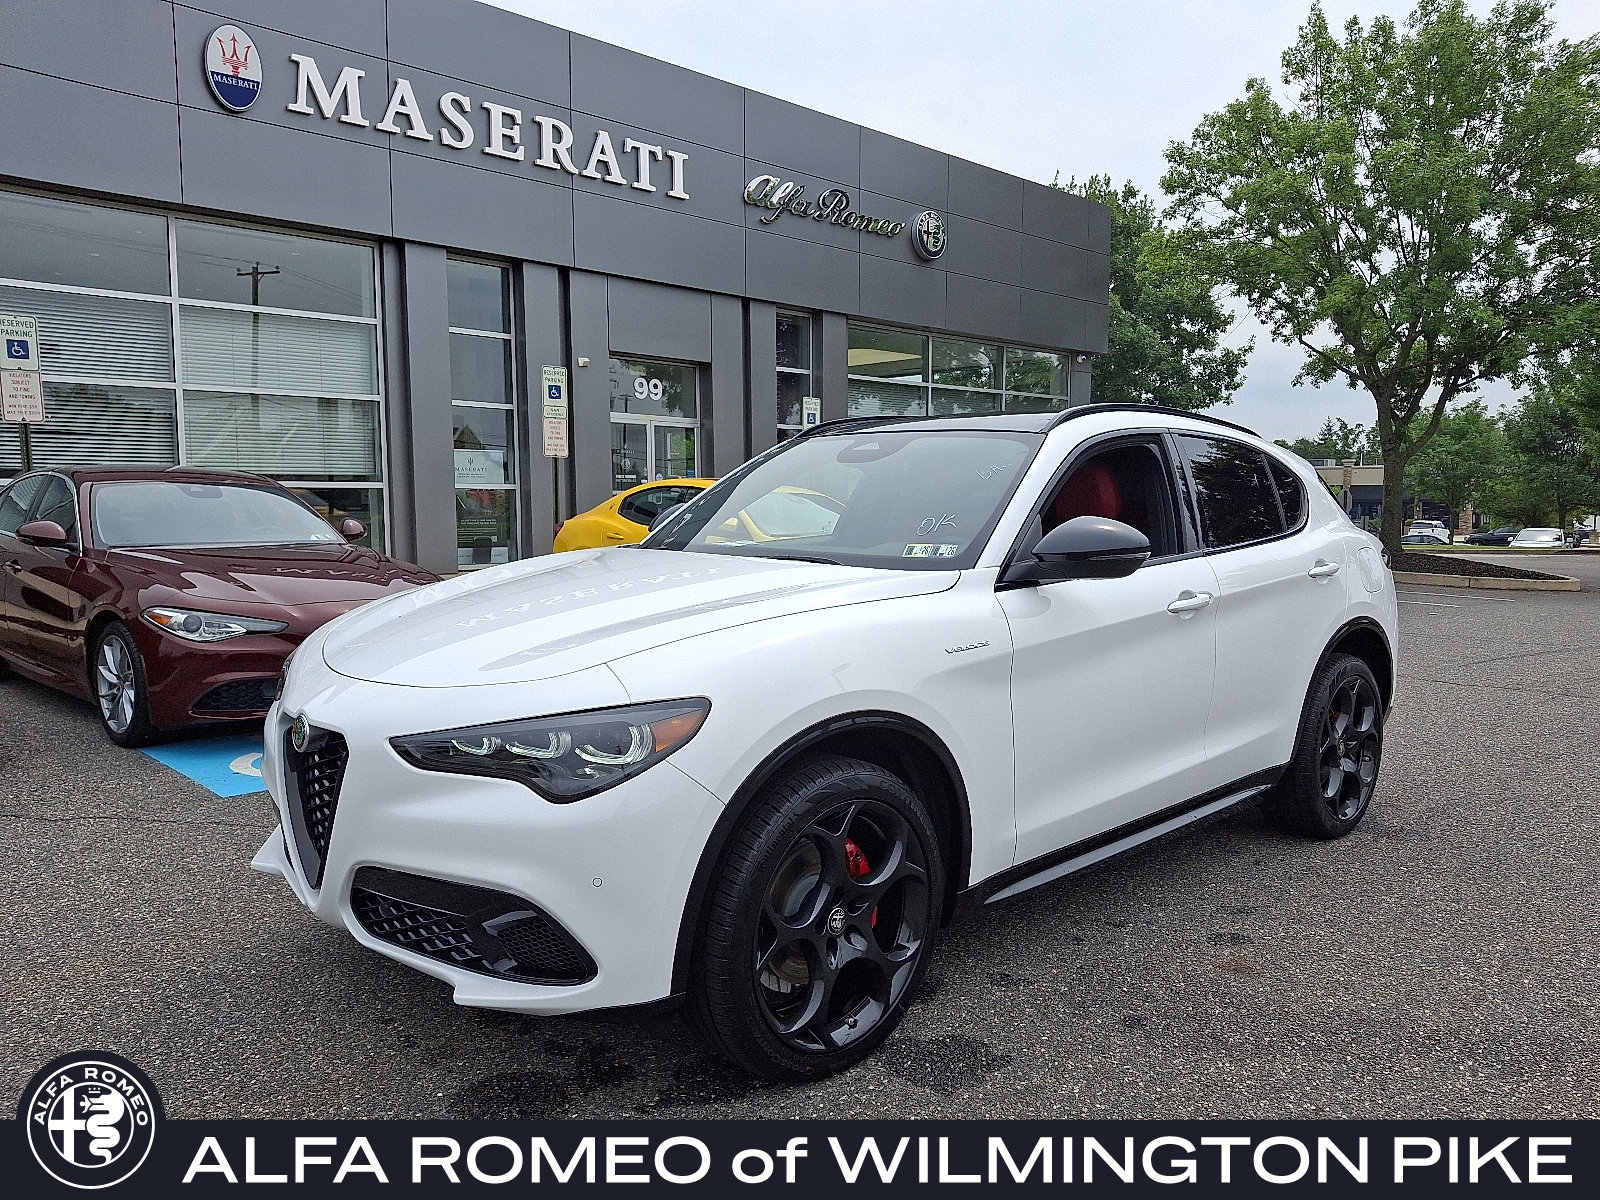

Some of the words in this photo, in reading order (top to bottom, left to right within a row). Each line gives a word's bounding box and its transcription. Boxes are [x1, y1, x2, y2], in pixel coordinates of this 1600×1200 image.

[213, 73, 258, 91] MASERATI
[287, 52, 689, 200] MASERATI
[814, 188, 906, 237] Romeo
[0, 328, 33, 338] PARKING
[633, 377, 663, 401] 99
[917, 513, 957, 536] OK
